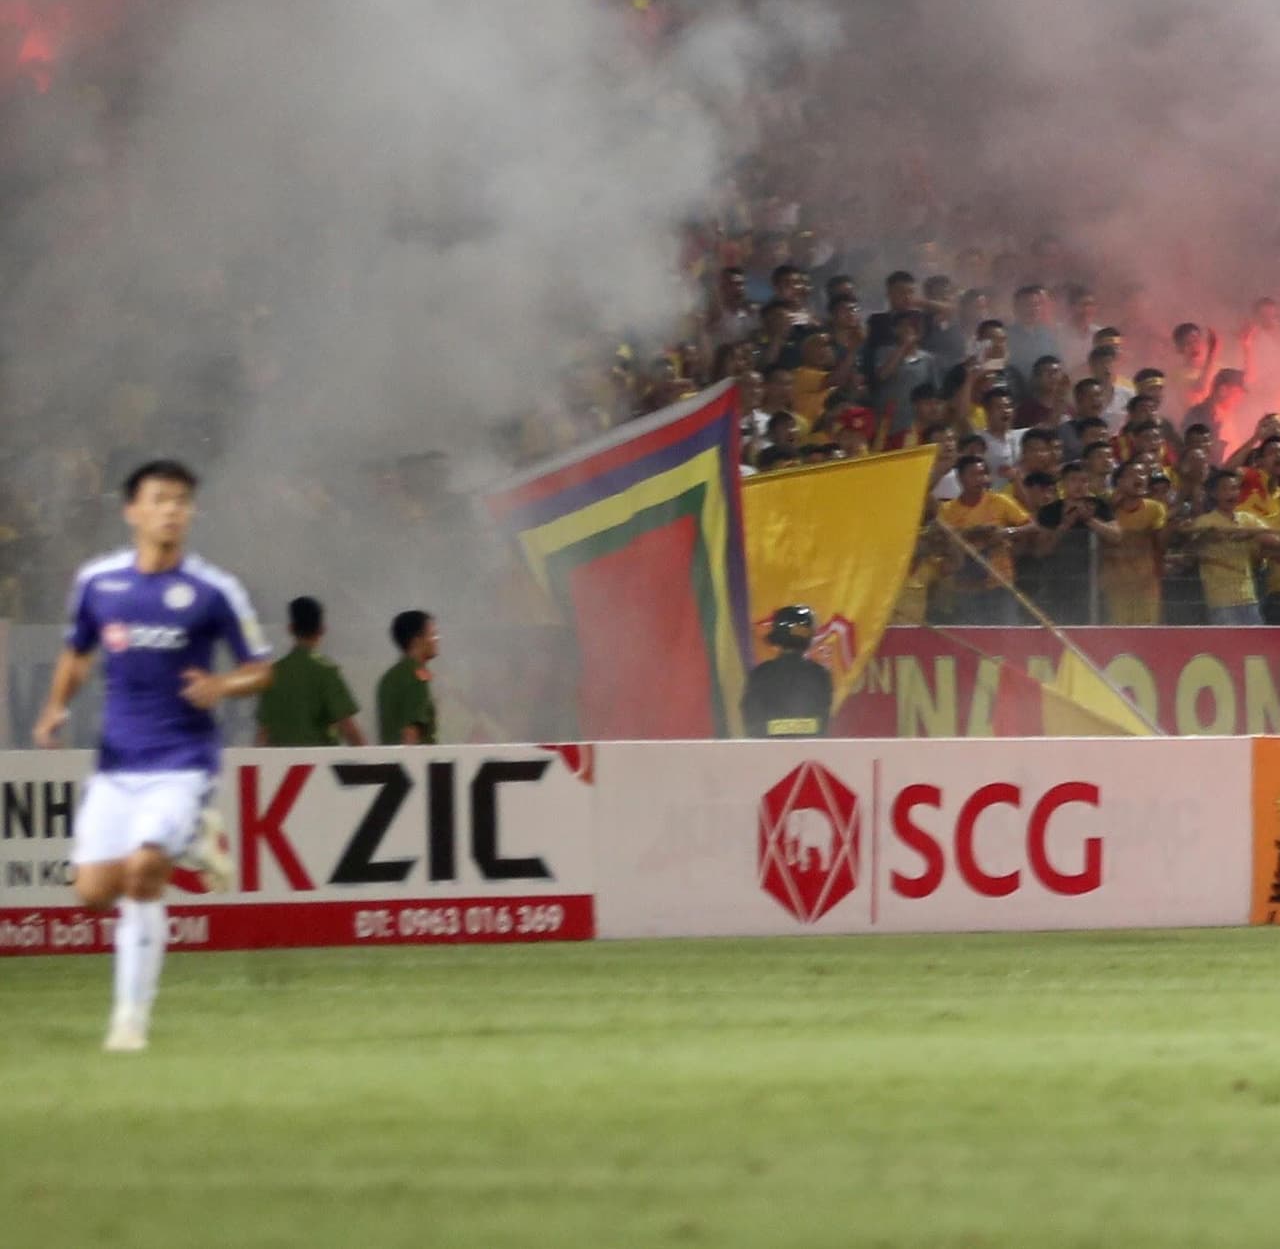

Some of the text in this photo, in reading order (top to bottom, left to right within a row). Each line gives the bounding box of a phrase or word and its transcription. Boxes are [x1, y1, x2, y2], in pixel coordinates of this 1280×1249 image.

[327, 758, 558, 884] ZIC
[890, 781, 1104, 899] SCG
[399, 908, 460, 937] 0963
[465, 906, 513, 934] 016
[516, 904, 565, 932] 369
